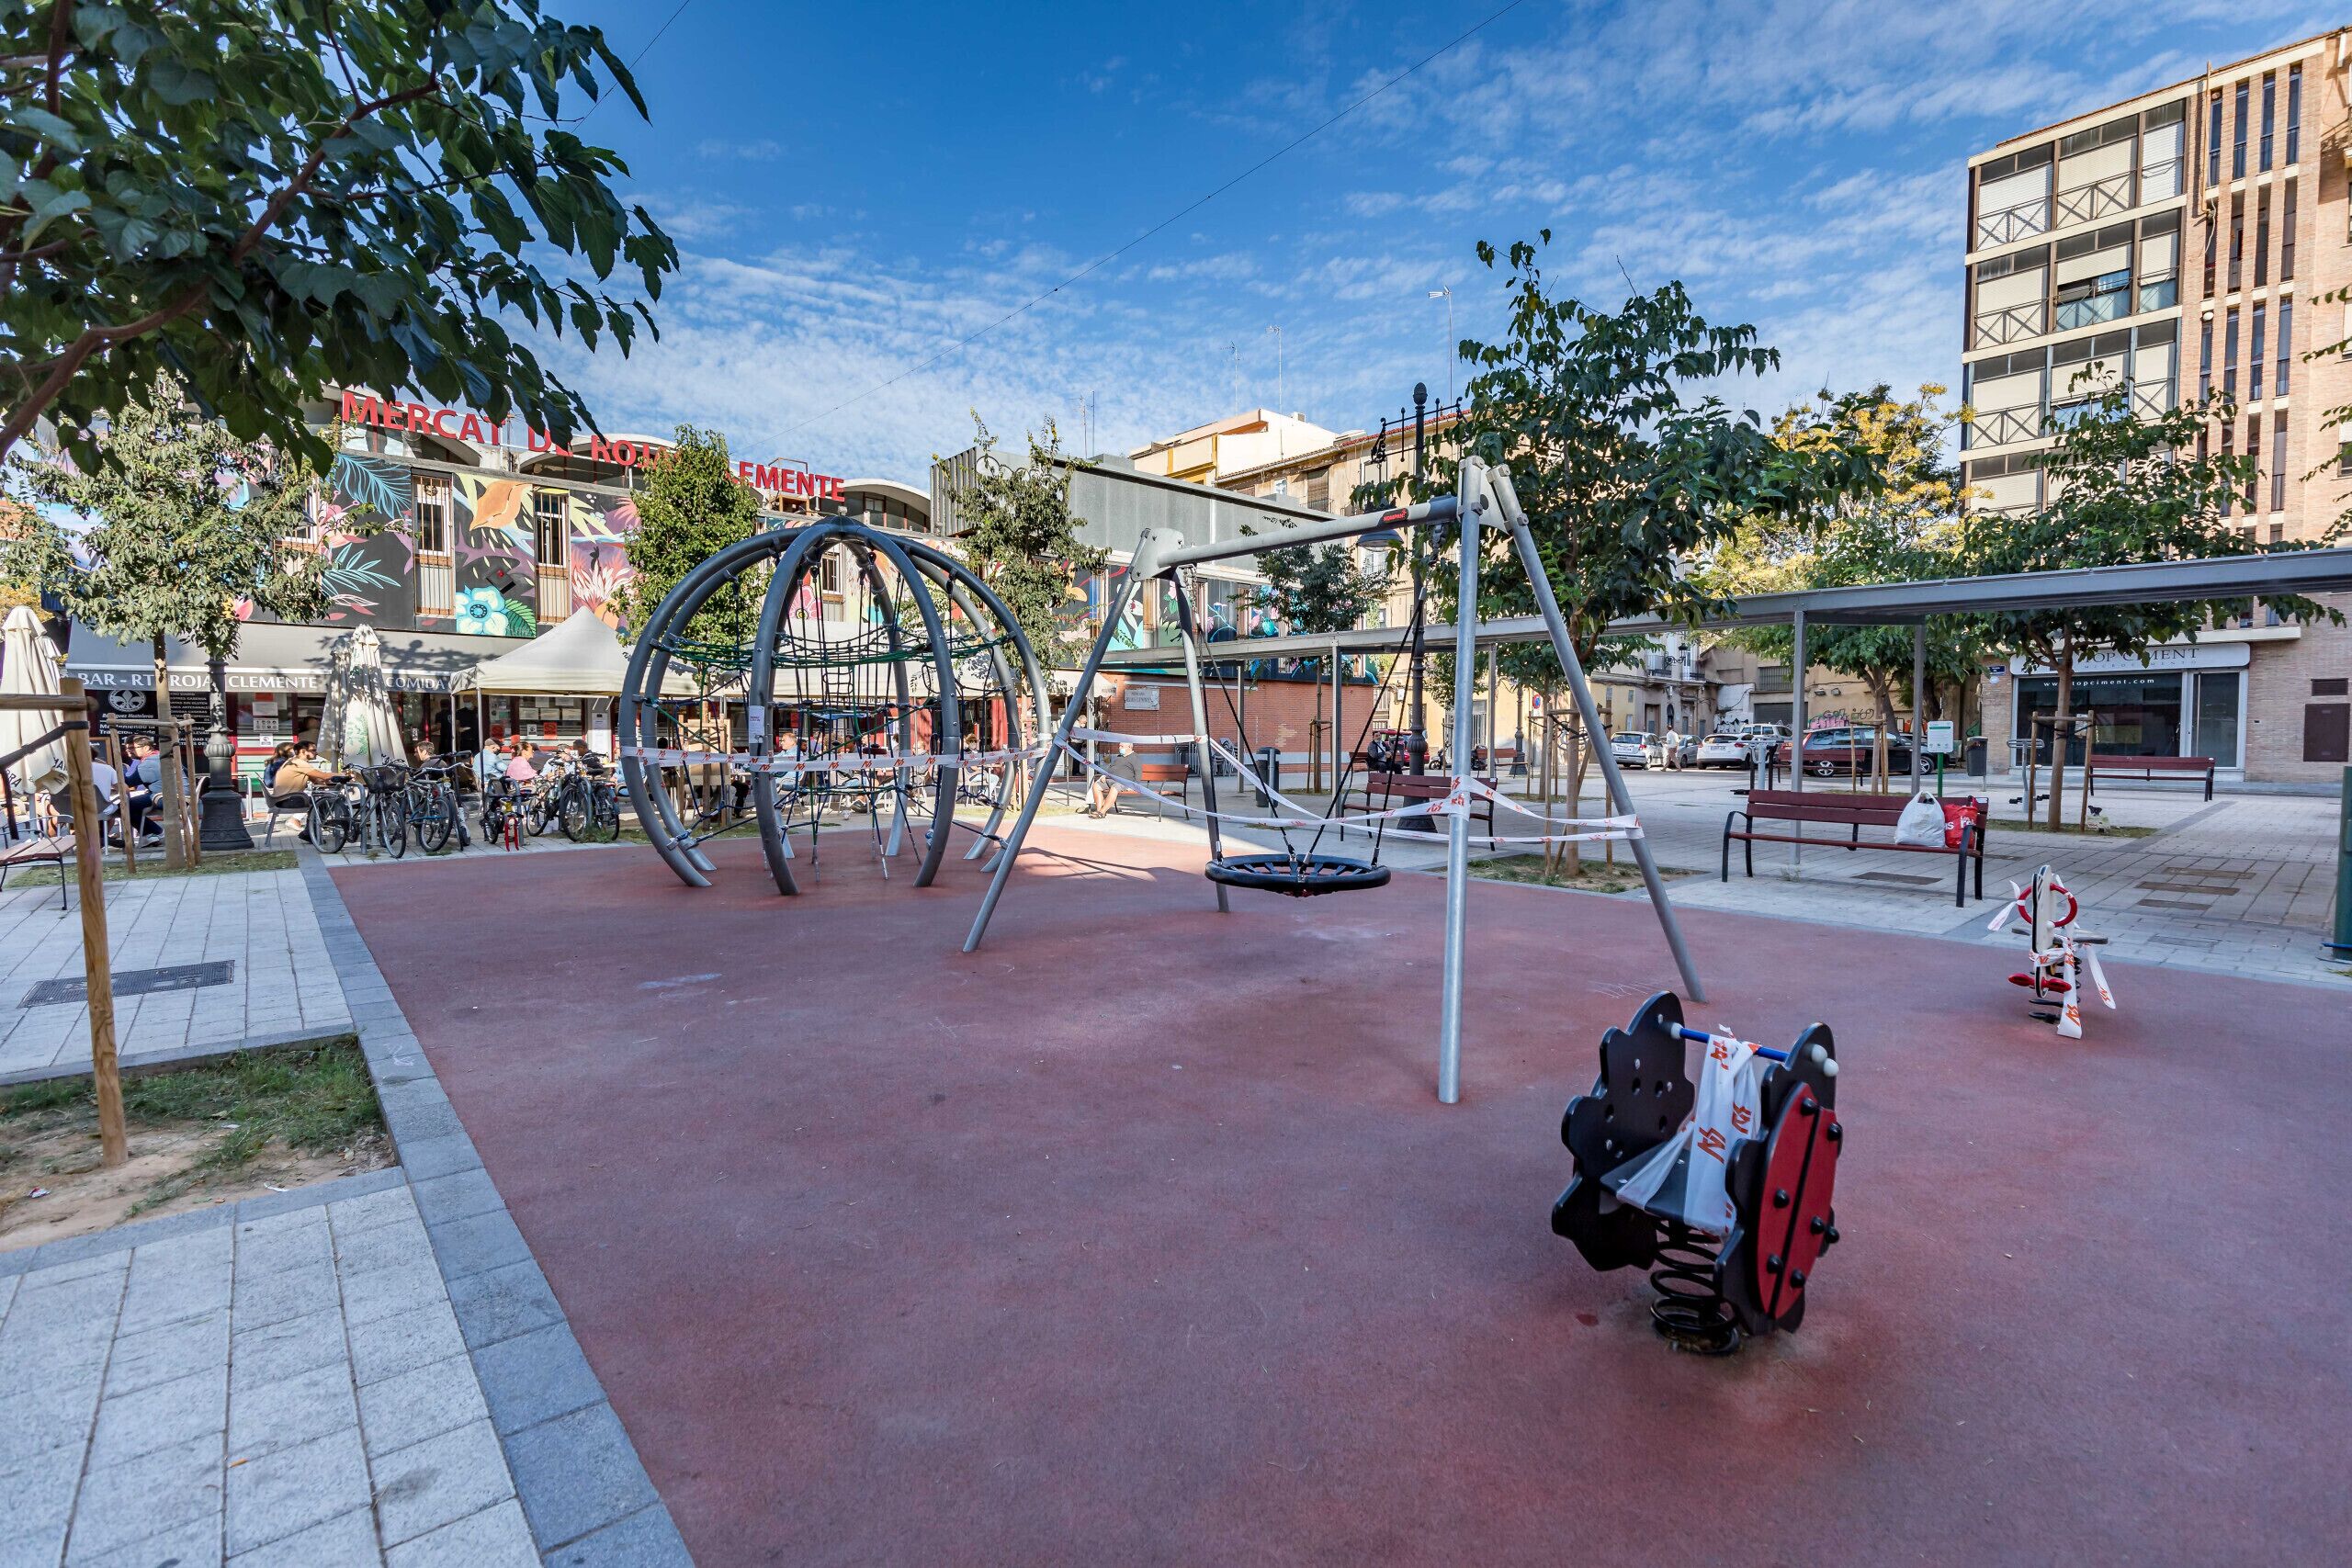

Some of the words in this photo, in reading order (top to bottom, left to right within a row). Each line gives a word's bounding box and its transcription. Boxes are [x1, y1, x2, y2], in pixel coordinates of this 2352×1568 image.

[342, 391, 507, 446] MERCAT
[591, 434, 684, 471] ROJA
[724, 460, 845, 502] EMENTE
[78, 673, 117, 686] BAR
[170, 675, 211, 688] ROJA
[229, 675, 318, 689] CLEMENTE
[385, 676, 446, 690] COMIDA
[2043, 678, 2155, 687] wwtopciment.com
